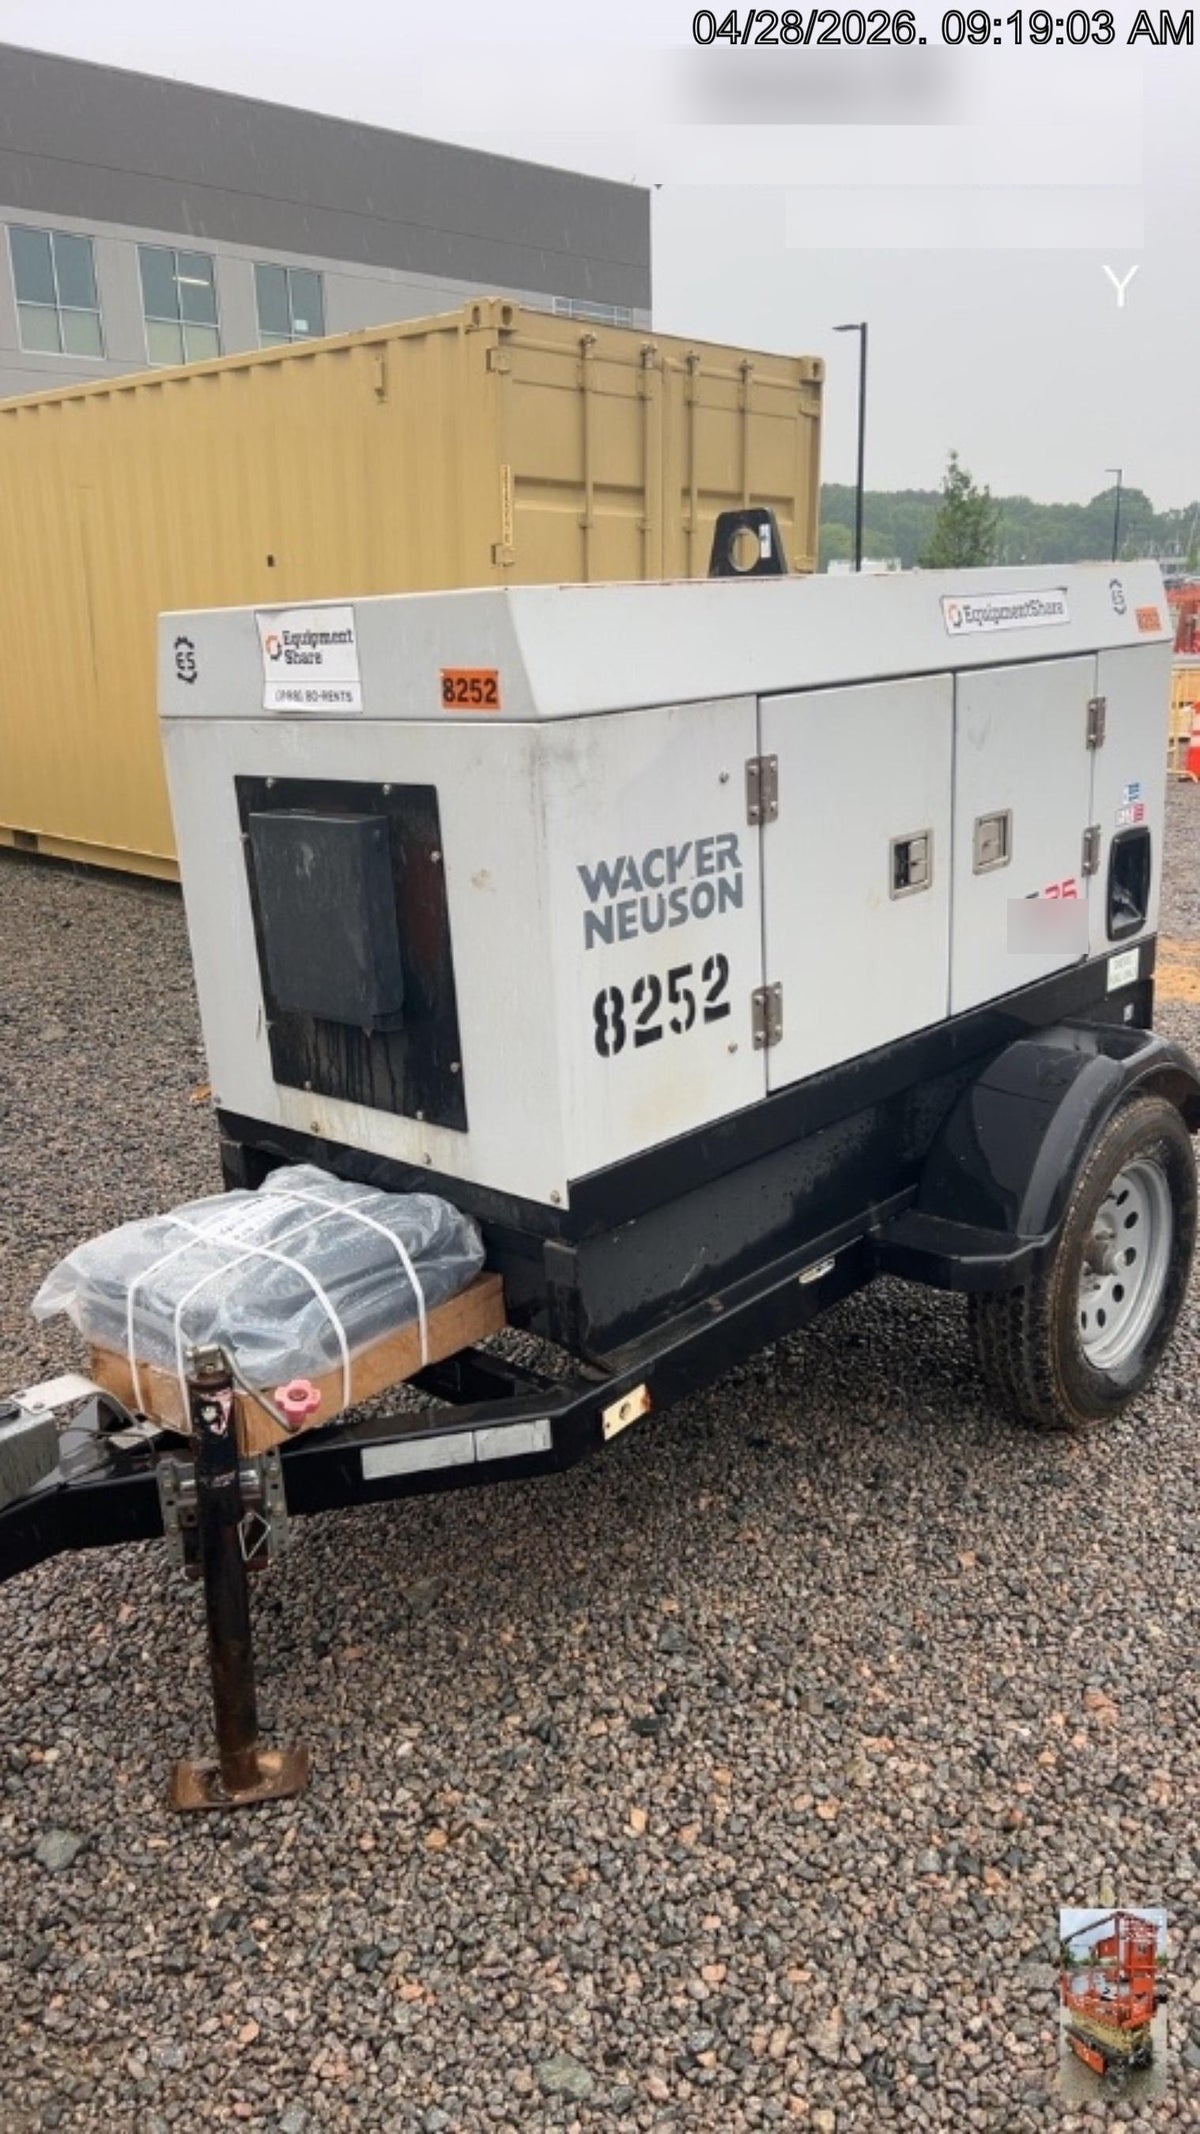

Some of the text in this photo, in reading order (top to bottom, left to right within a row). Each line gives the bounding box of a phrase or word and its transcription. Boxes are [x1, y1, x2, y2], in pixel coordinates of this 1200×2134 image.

[962, 599, 1065, 626] EquipmentShare
[282, 629, 354, 649] Equipment
[284, 649, 323, 665] Share
[442, 677, 498, 705] 8252
[577, 832, 744, 904] WACKER
[582, 872, 744, 951] NEUSON
[593, 952, 731, 1058] 8252
